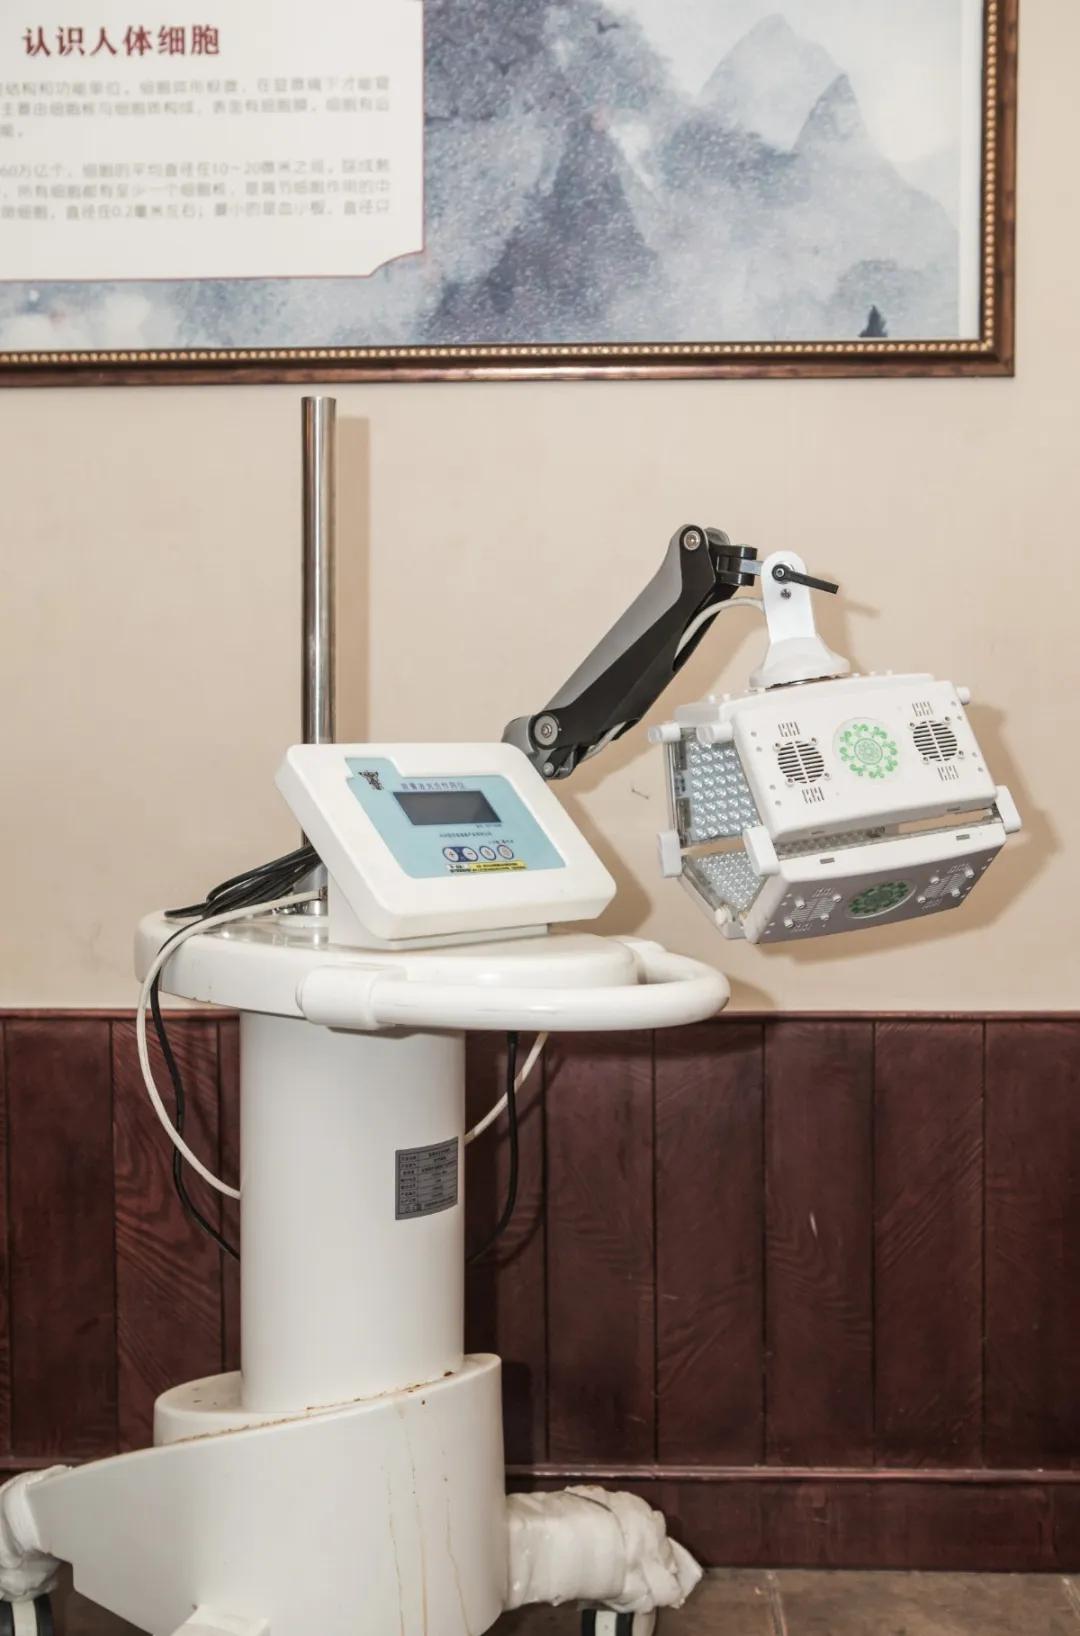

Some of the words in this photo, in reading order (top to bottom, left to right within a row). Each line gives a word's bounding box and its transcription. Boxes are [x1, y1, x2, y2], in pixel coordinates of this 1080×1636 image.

[22, 24, 221, 57] 认识人体细胞
